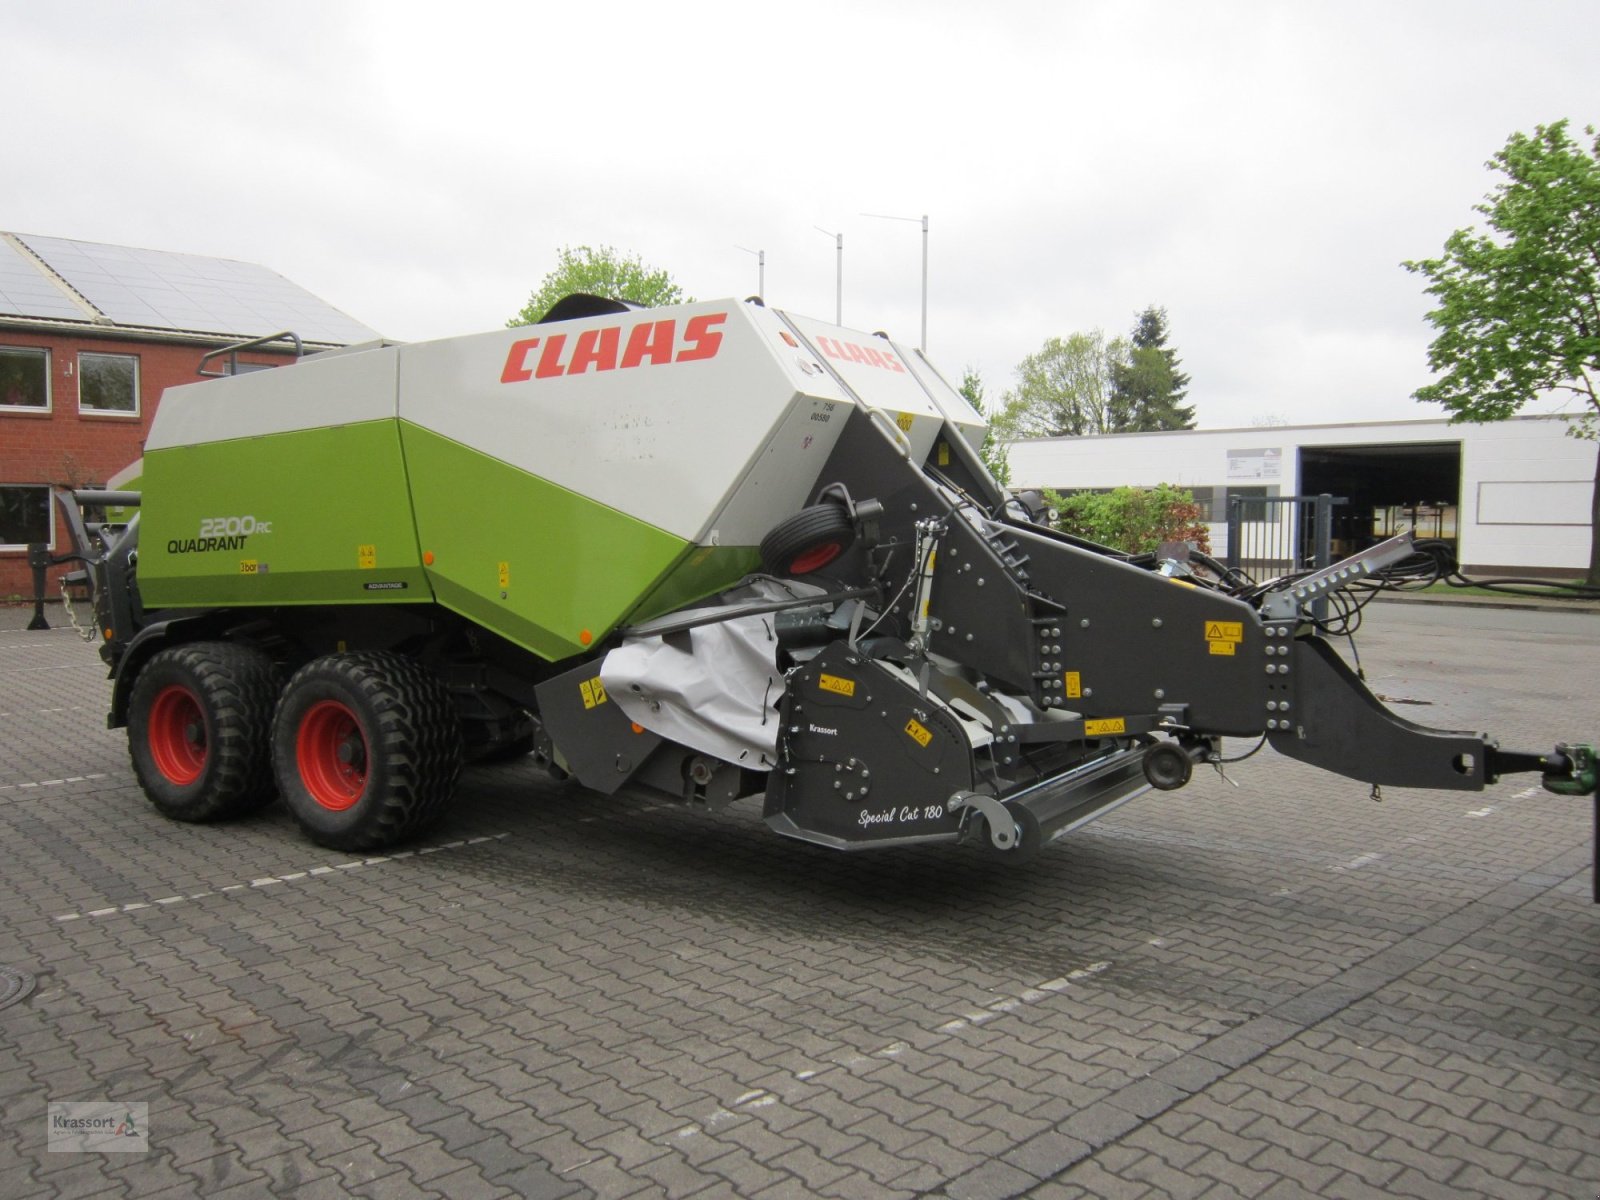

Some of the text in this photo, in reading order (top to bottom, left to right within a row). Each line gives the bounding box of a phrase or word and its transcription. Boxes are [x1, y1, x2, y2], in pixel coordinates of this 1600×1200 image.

[500, 312, 728, 384] CLAAS
[815, 335, 906, 374] CLAAS
[167, 535, 248, 554] QUADRANT
[809, 723, 839, 736] Krassort
[858, 805, 943, 828] Special Cut 180
